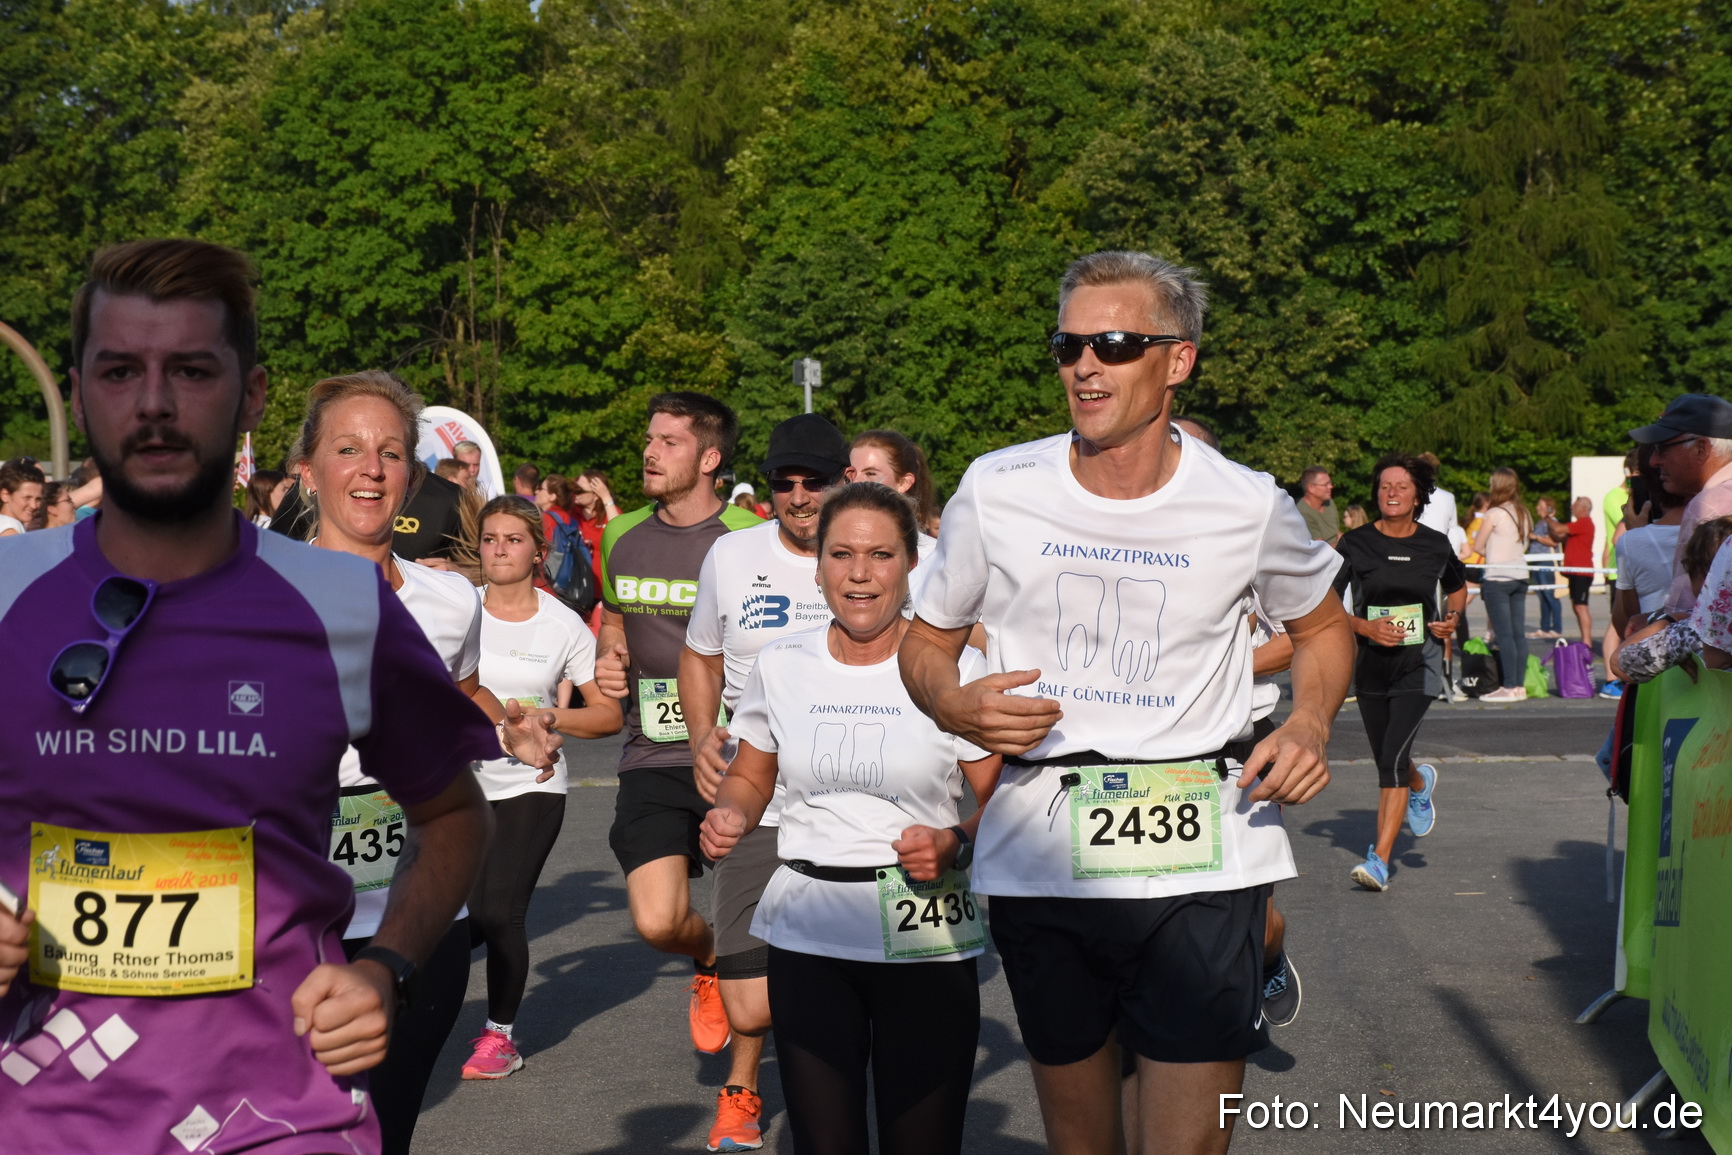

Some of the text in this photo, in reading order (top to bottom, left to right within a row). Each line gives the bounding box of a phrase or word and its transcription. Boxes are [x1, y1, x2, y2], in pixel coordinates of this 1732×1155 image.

[1009, 461, 1036, 471] JAKO
[1041, 541, 1190, 569] ZAHNARZTPRAXIS
[646, 606, 658, 616] by
[660, 608, 688, 616] smart
[795, 612, 829, 622] Bayern
[1037, 681, 1175, 708] RALF GÜNTER HELM
[809, 704, 902, 716] ZAHNARZTPRAXIS
[35, 728, 277, 758] WIR SIND LILA.
[810, 788, 832, 798] RALF
[1092, 787, 1151, 800] firmenlauf
[1184, 791, 1210, 802] 2019
[1089, 803, 1201, 846] 2438
[333, 822, 406, 866] 435
[59, 859, 145, 881] firmenlauf
[154, 872, 239, 889] walk 2019
[896, 880, 944, 894] firmenlauf
[72, 891, 200, 948] 877
[895, 889, 976, 932] 2436
[43, 944, 235, 967] Baumg Rtner Thomas
[67, 965, 206, 980] FUCHS & Söhne Service
